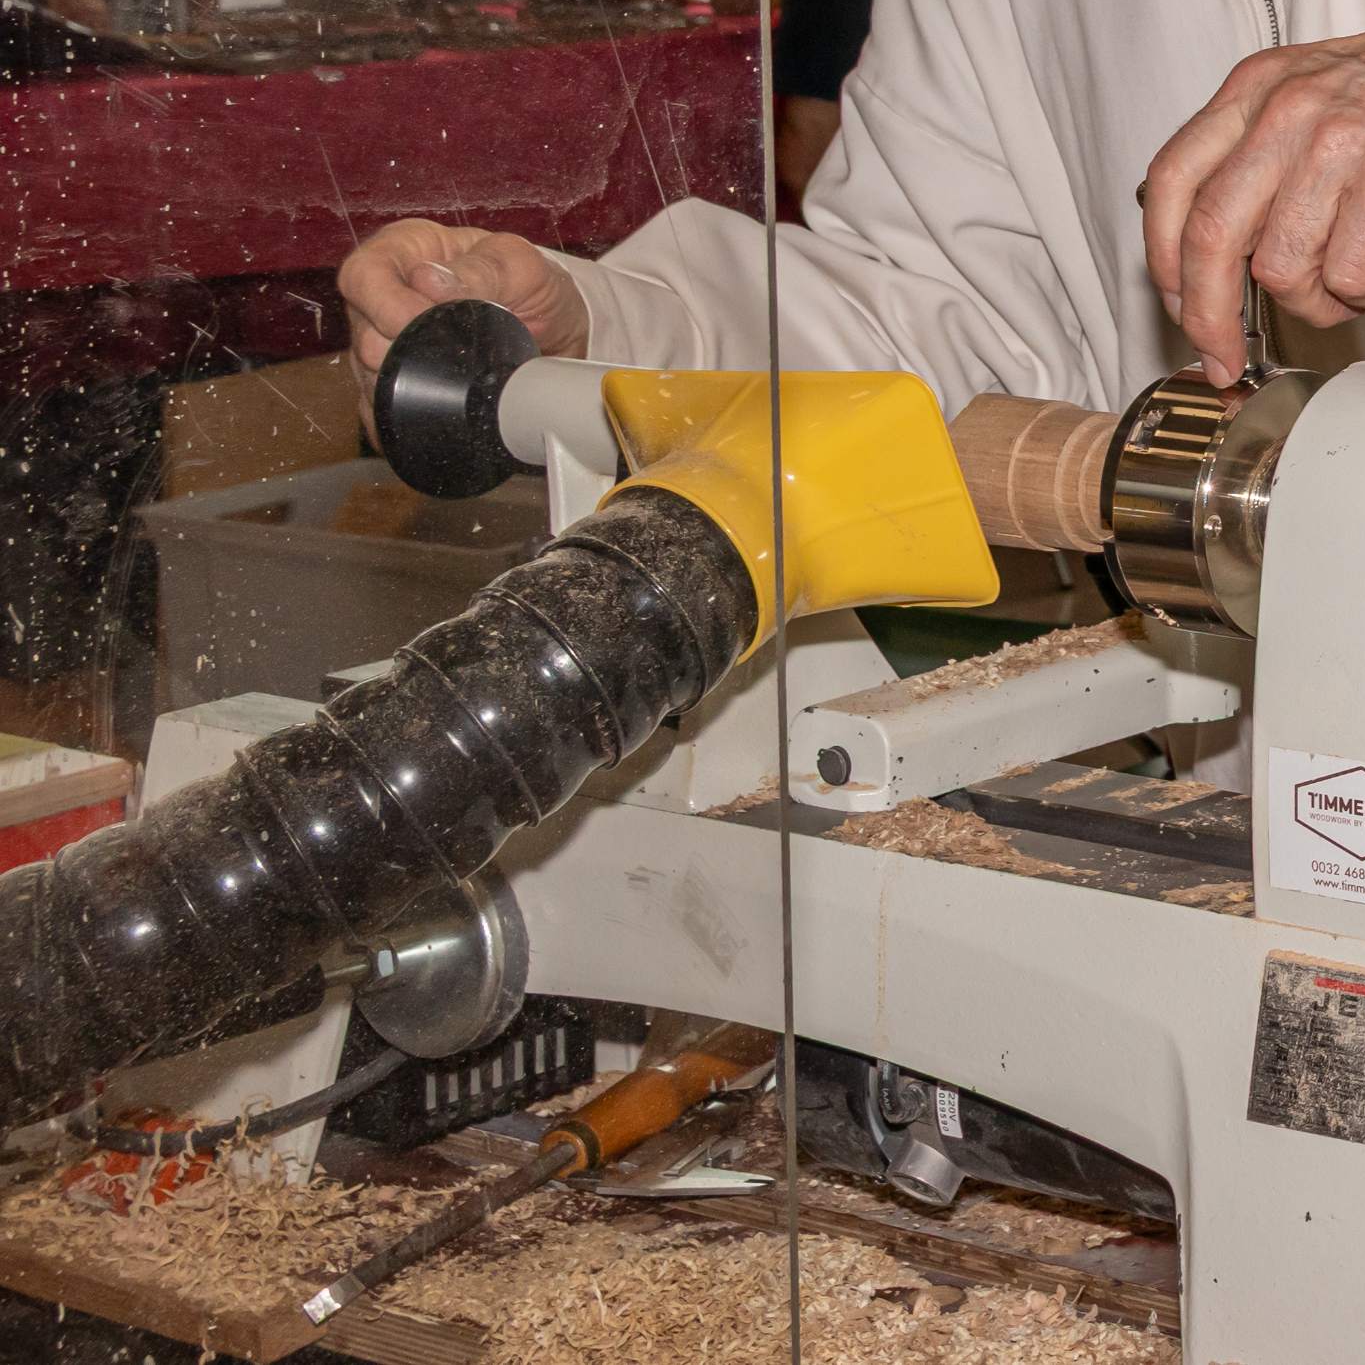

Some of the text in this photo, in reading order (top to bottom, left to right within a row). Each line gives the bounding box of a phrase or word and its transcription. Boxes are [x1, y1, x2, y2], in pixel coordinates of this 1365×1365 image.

[1309, 812, 1352, 826] WOODWORK
[1354, 819, 1363, 828] BY
[1311, 860, 1340, 876] 0032
[1344, 866, 1365, 881] 468
